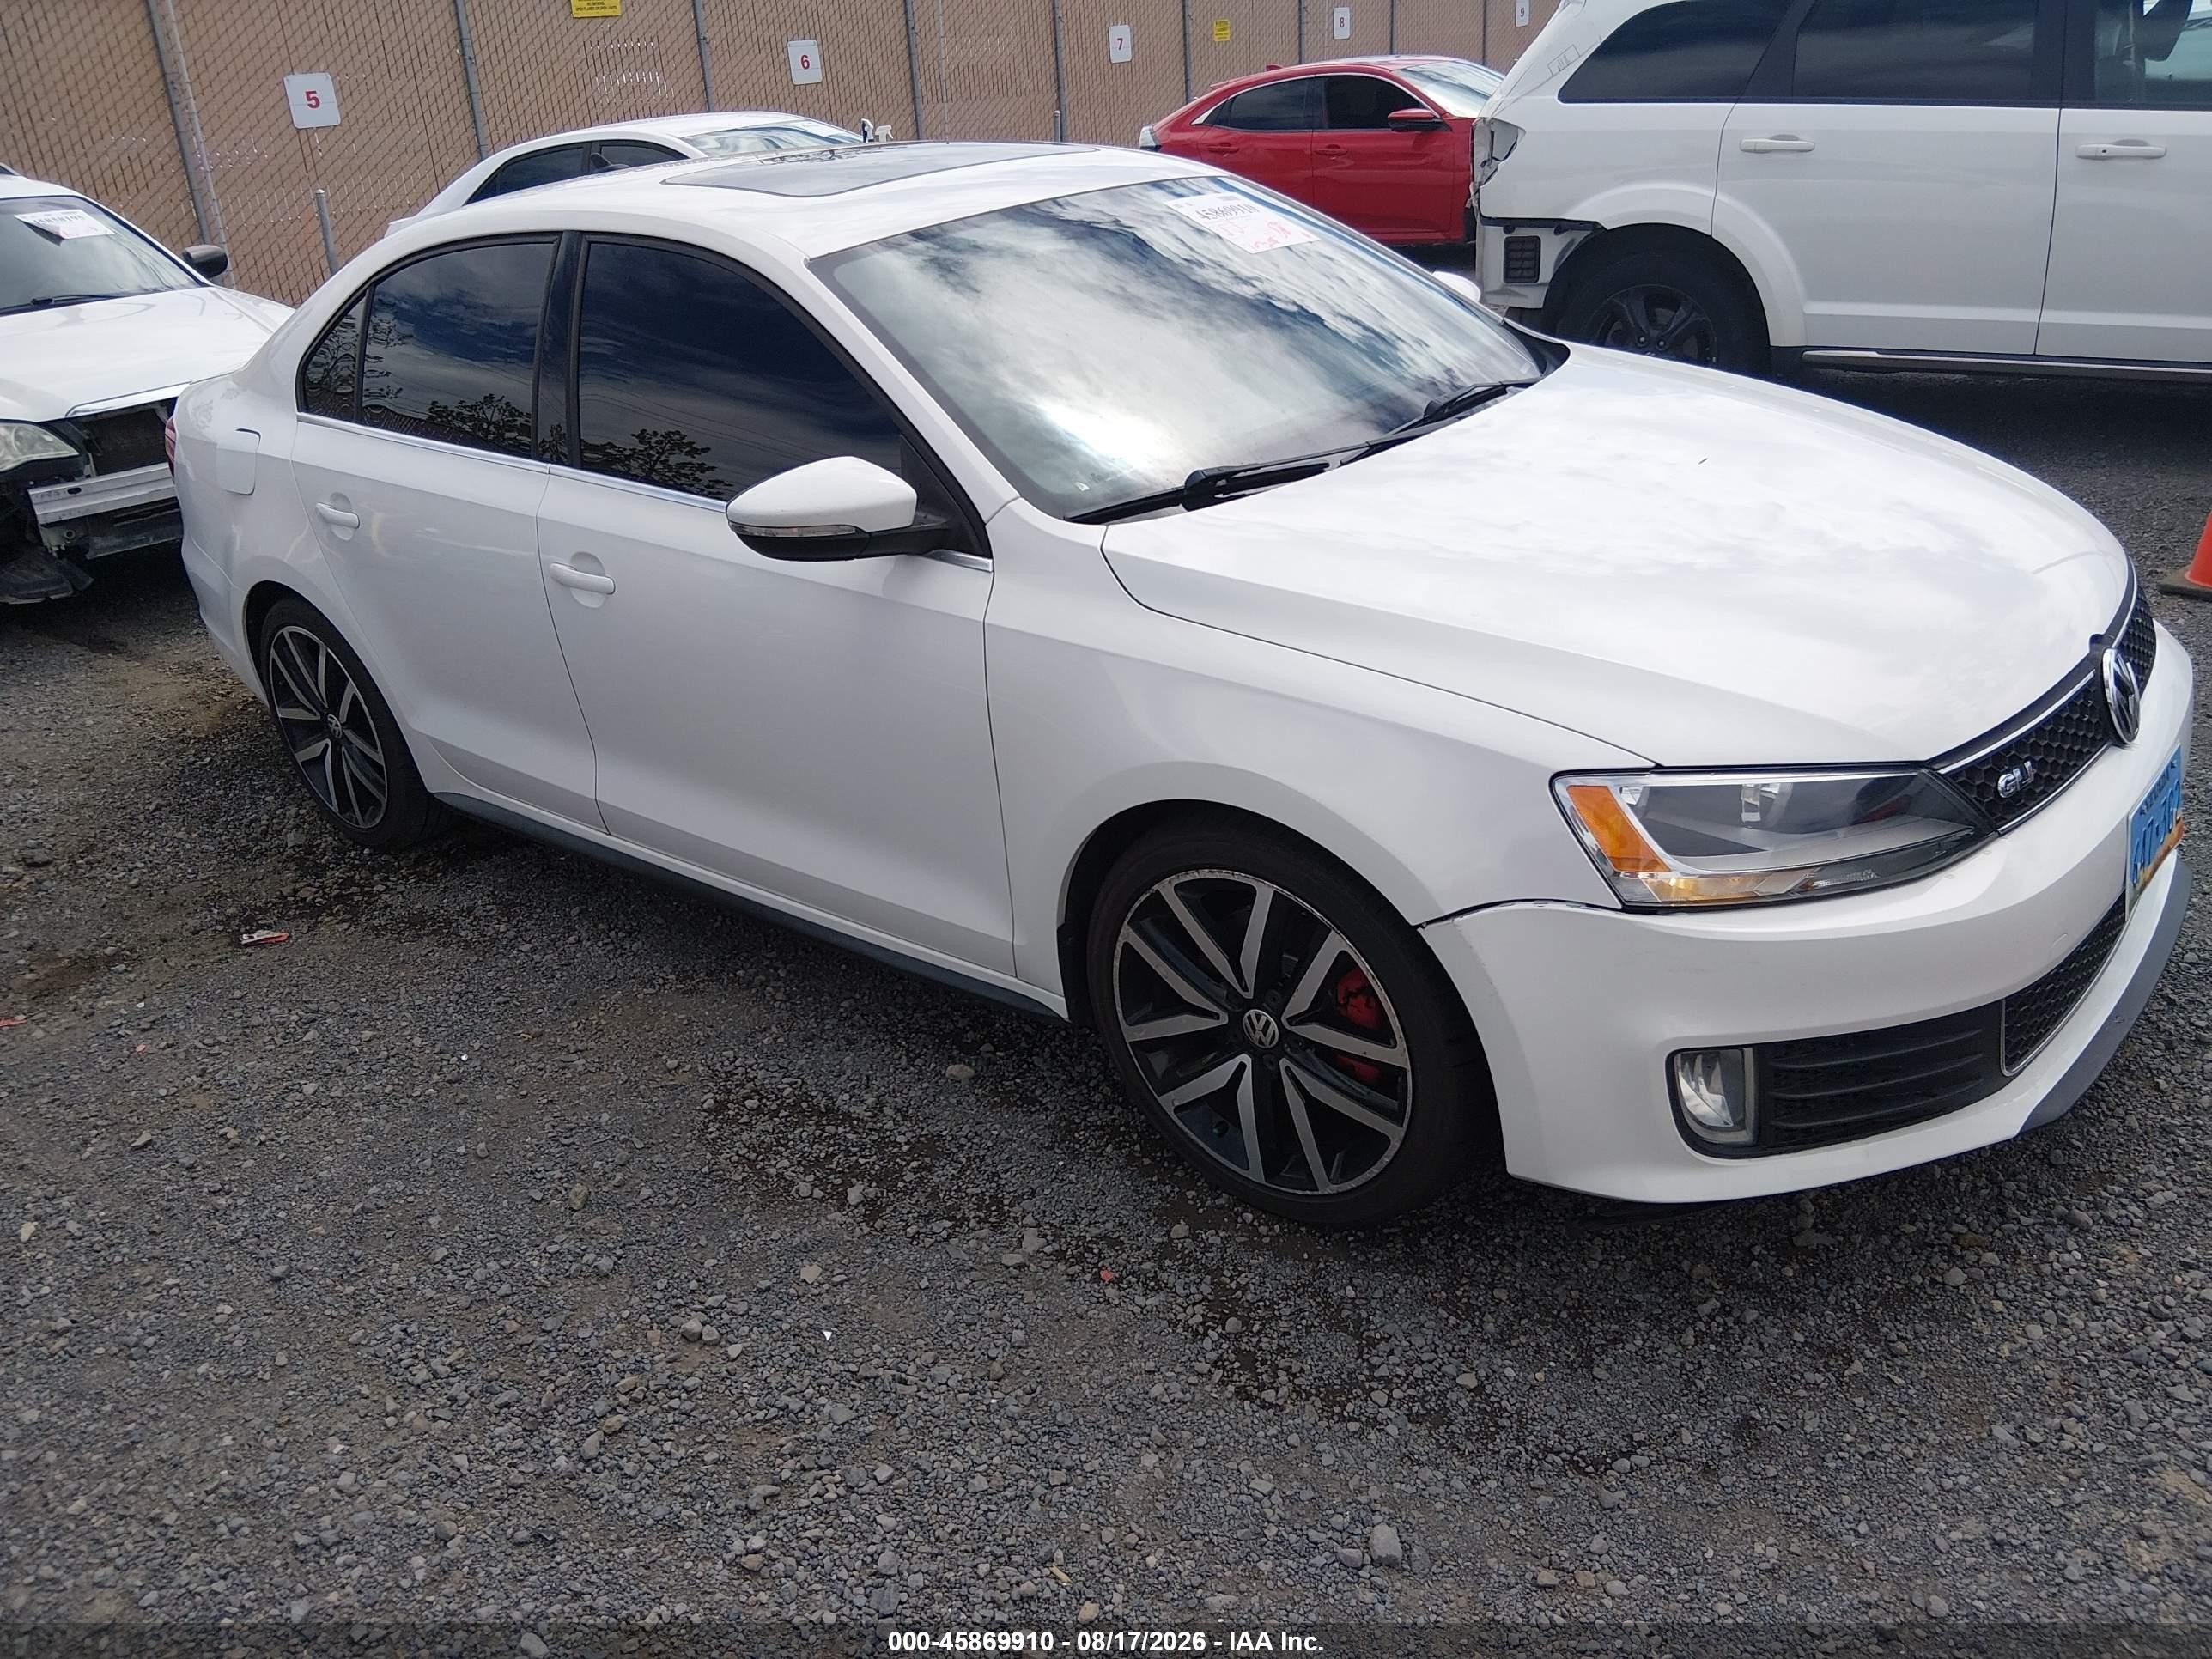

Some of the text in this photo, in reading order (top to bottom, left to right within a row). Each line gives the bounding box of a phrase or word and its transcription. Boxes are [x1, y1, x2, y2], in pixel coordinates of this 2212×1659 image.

[1520, 7, 1525, 17] 9
[1339, 16, 1346, 28] 8
[1116, 38, 1124, 51] 7
[800, 54, 811, 70] 6
[304, 90, 321, 109] 5
[1998, 761, 2035, 799] GLI
